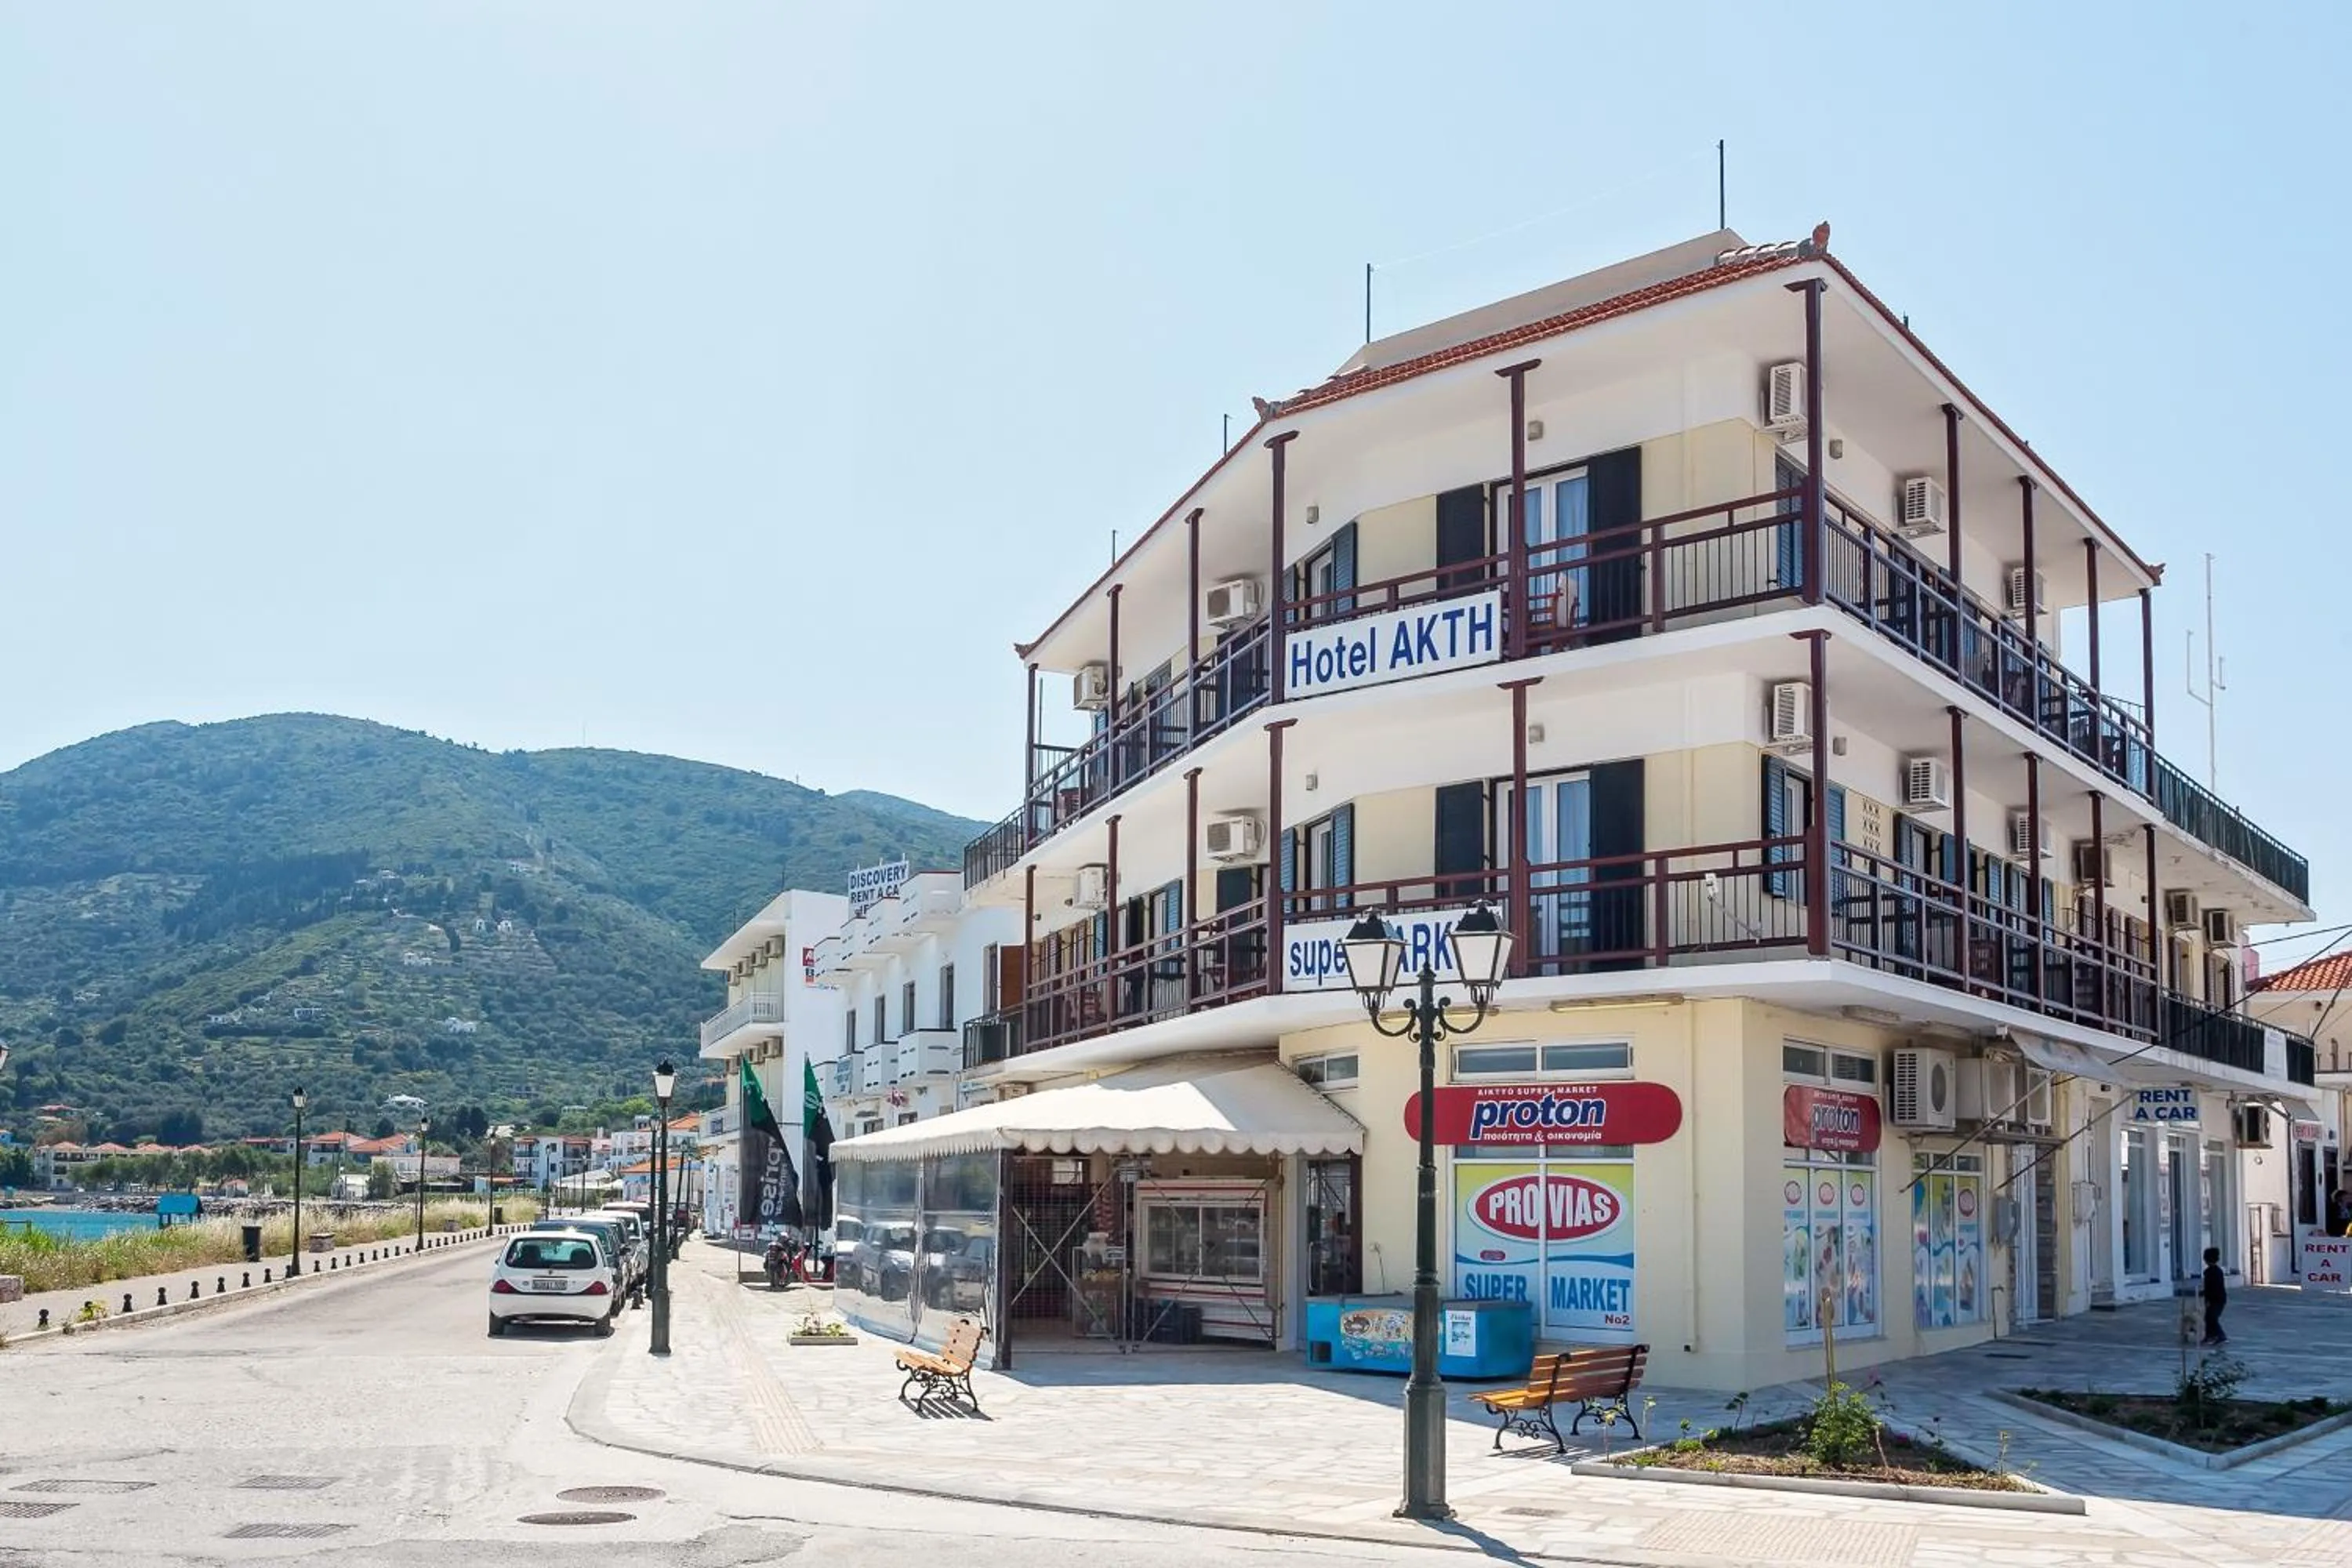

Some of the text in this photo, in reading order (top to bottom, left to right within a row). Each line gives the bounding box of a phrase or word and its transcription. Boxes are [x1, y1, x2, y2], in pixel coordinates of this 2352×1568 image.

[1291, 603, 1493, 688] Hotel AKTH
[851, 863, 908, 889] DISCOVERY
[851, 884, 900, 903] RENT A CA
[1290, 938, 1346, 985] supe
[1516, 1087, 1550, 1095] SUPER
[1556, 1086, 1598, 1094] MARKET
[2139, 1089, 2192, 1104] RENT
[1469, 1092, 1606, 1141] proton
[1810, 1099, 1860, 1142] proton
[2135, 1106, 2196, 1120] A CAR
[1534, 1130, 1544, 1142] &
[1489, 1184, 1611, 1229] PROVIAS
[2305, 1243, 2350, 1254] RENT
[2321, 1258, 2332, 1268] A
[2307, 1272, 2342, 1283] CAR
[1464, 1272, 1631, 1312] SUPER MARKET
